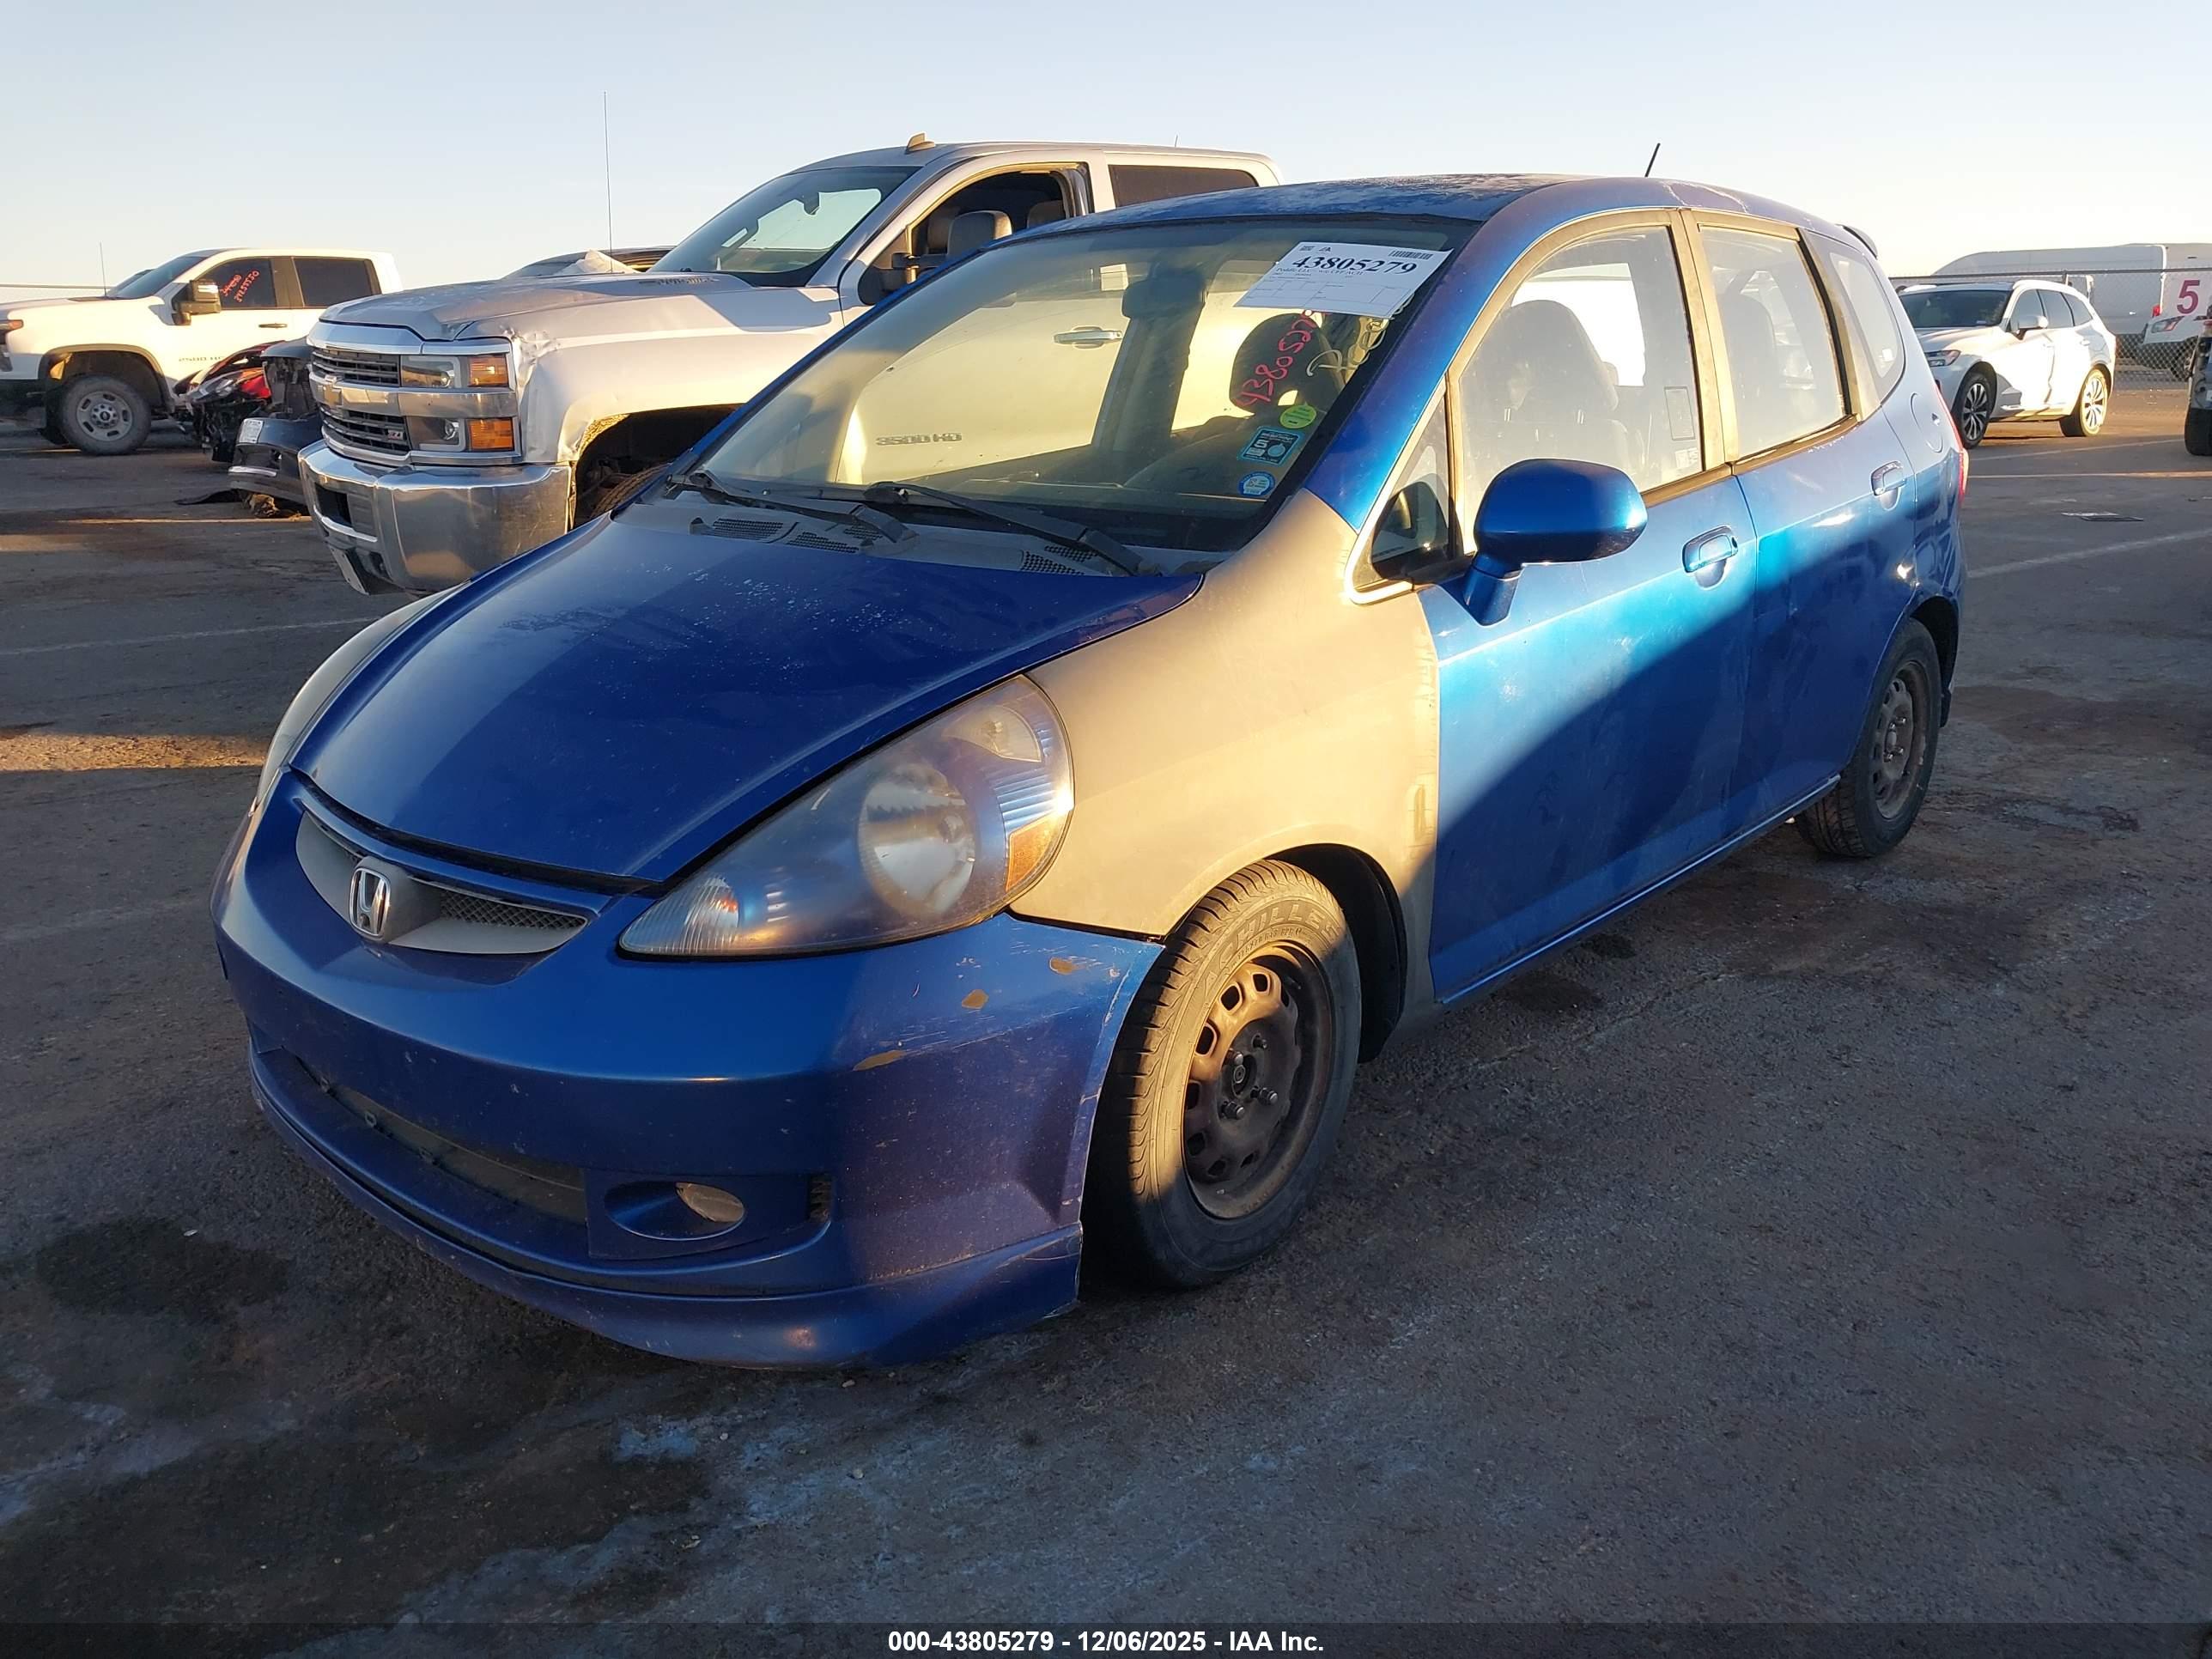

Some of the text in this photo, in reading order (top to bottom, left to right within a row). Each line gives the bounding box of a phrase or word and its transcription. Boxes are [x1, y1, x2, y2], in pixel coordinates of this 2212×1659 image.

[1292, 256, 1417, 275] 43805279
[2177, 279, 2200, 314] 5
[876, 432, 963, 446] 3500 HD
[1204, 903, 1342, 994] ACHILLES
